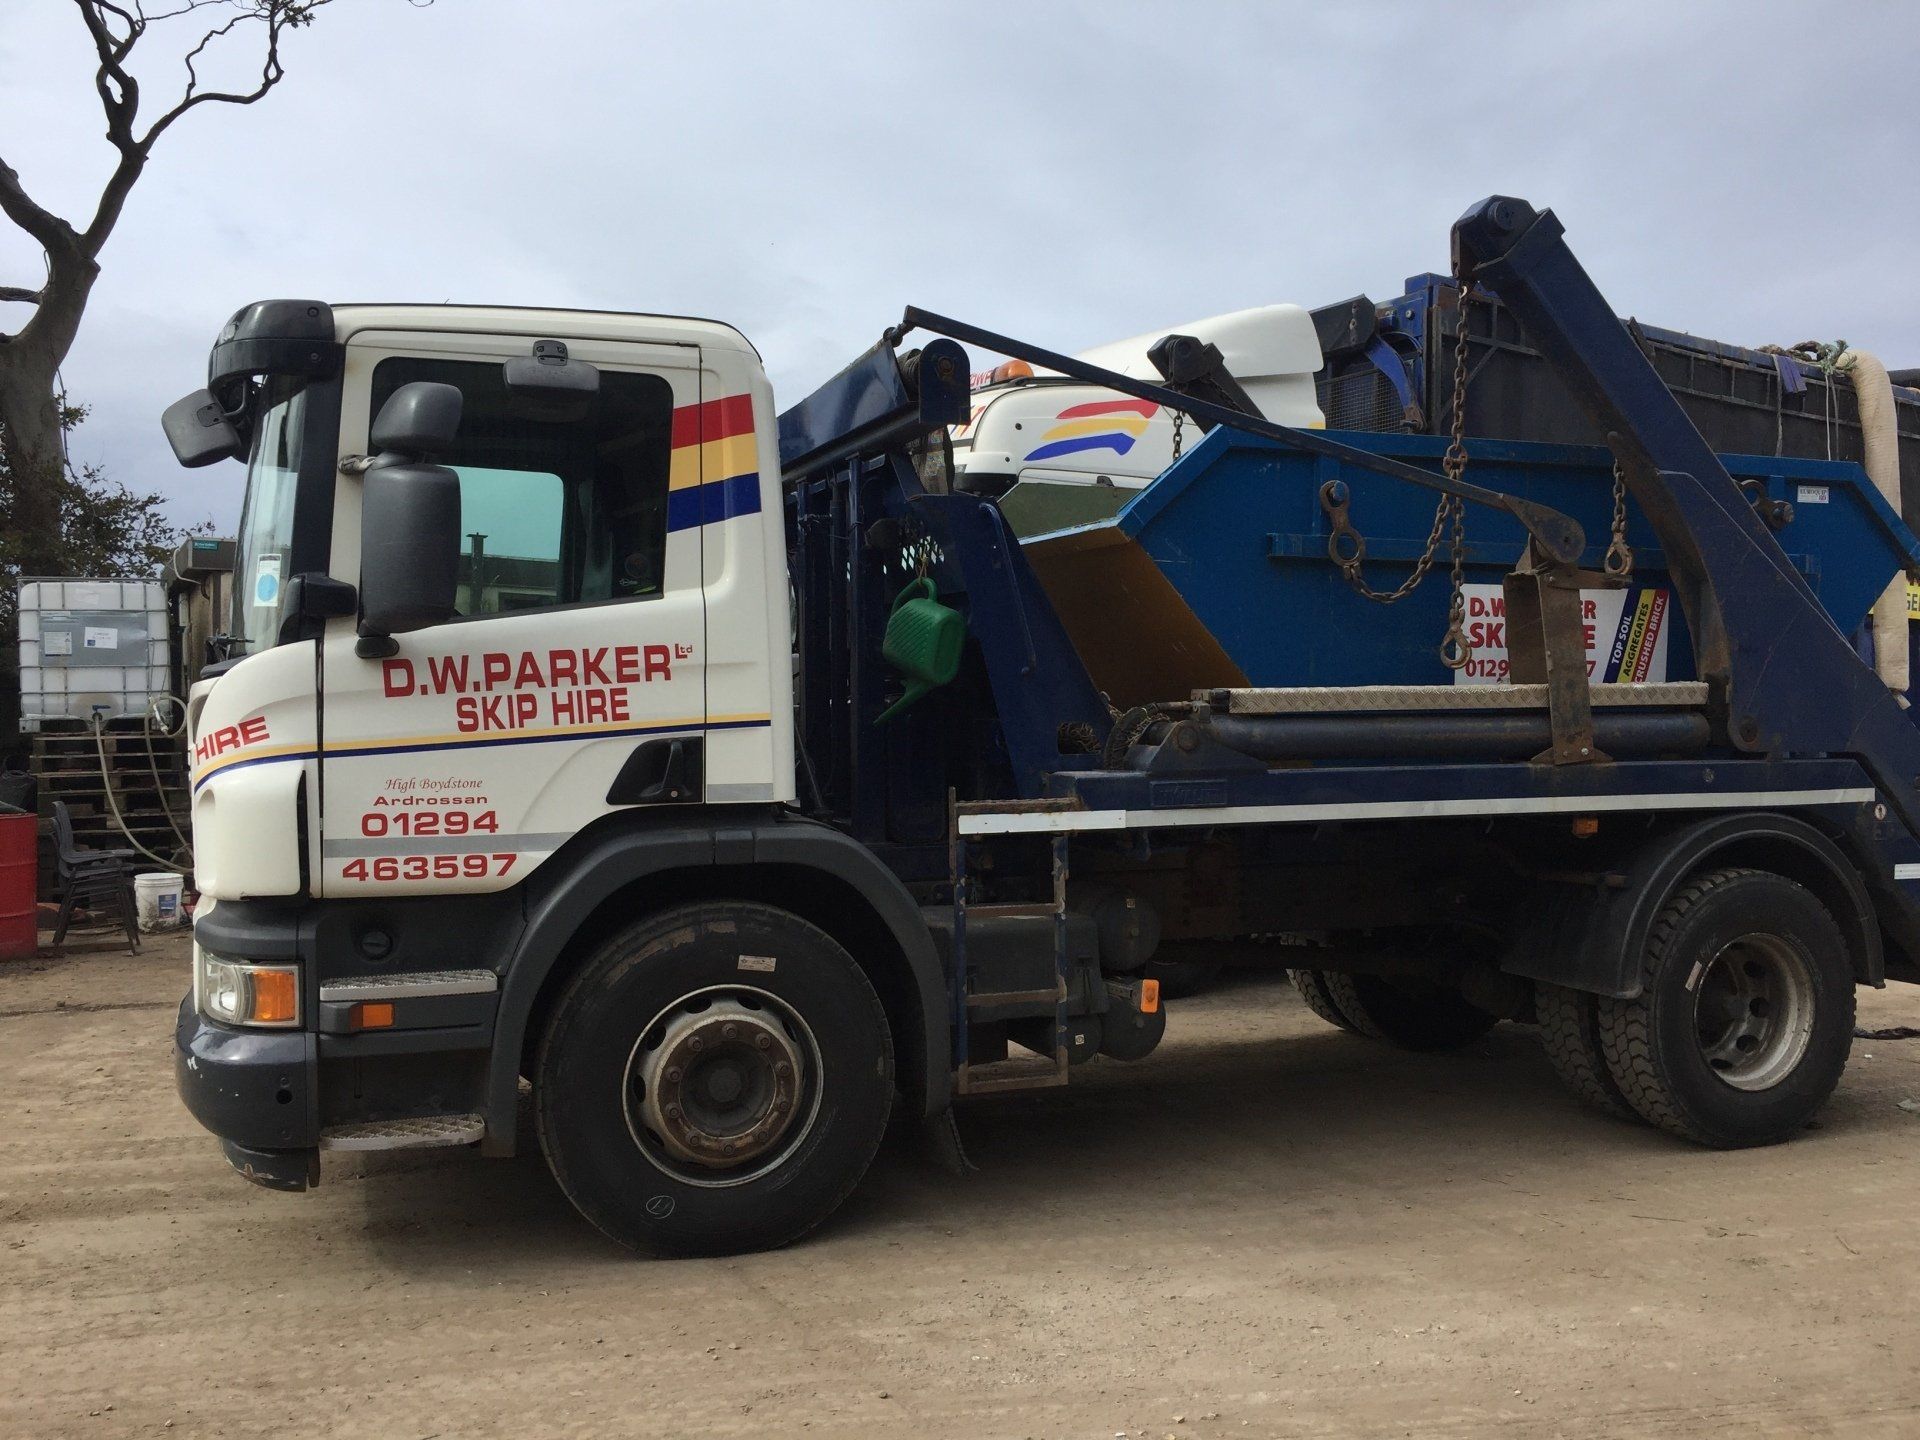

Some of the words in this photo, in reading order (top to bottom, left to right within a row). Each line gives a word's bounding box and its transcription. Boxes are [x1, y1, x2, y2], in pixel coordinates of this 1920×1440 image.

[1469, 622, 1506, 649] SK
[1612, 641, 1624, 664] TOP
[1619, 616, 1632, 640] SOIL
[1623, 603, 1650, 677] AGGREGATES
[1635, 632, 1655, 684] CRUSHED
[1650, 596, 1665, 631] BRICK
[382, 645, 672, 698] D.W.PARKER
[675, 643, 693, 660] Ltd
[1465, 659, 1511, 678] 0129
[456, 693, 538, 732] SKIP
[552, 687, 630, 726] HIRE
[195, 715, 270, 766] HIRE
[373, 796, 488, 807] Ardrossan
[385, 777, 416, 793] High
[419, 777, 483, 793] Boydstone
[361, 810, 499, 837] 01294
[342, 853, 517, 882] 463597
